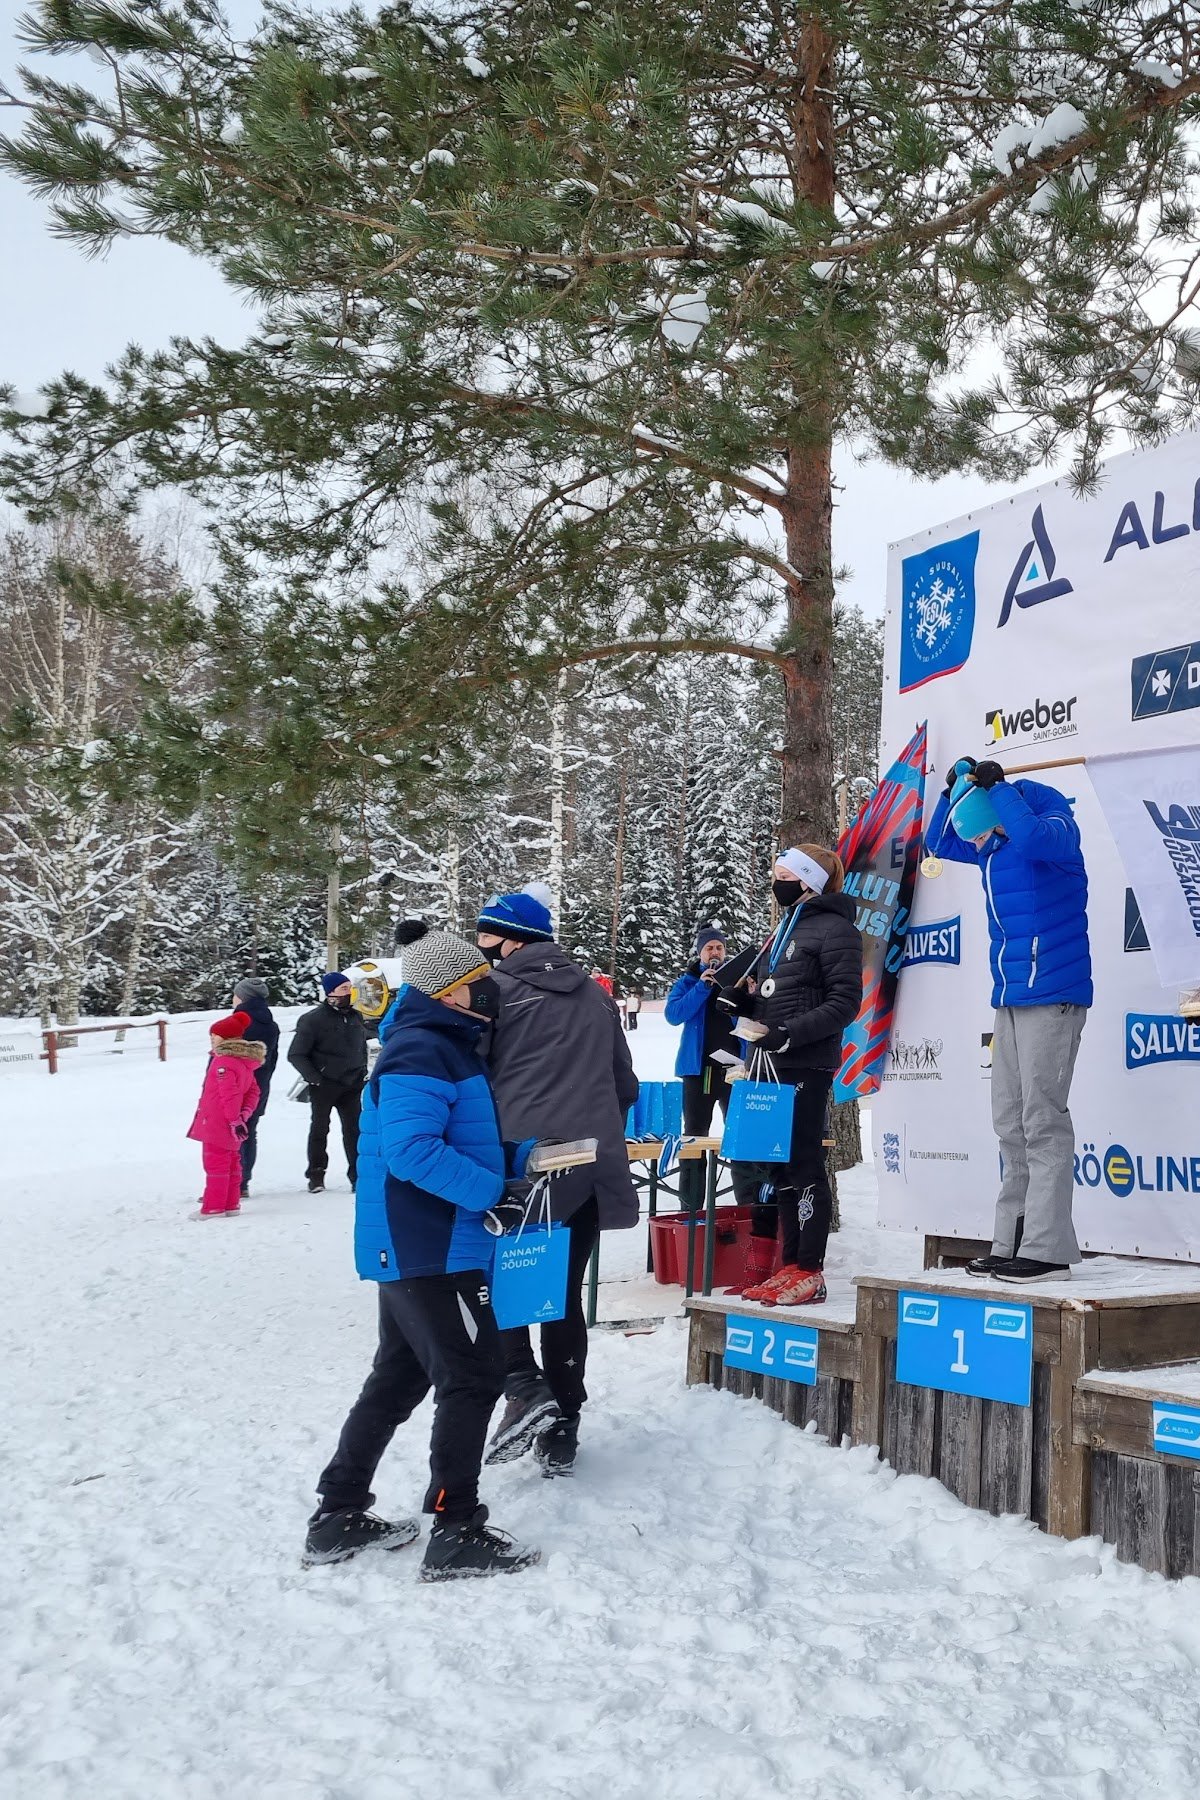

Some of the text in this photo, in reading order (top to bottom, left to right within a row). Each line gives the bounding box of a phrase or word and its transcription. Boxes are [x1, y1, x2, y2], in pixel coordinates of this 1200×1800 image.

[929, 561, 966, 599] SUUSALIIT
[1000, 697, 1077, 738] weber
[1032, 722, 1078, 741] SAINT-GOBAIN
[903, 925, 958, 961] ALVEST
[745, 1102, 771, 1111] JÕUDU
[746, 1093, 778, 1103] ANNAME
[501, 1245, 547, 1259] ANNAME
[501, 1257, 538, 1270] JÕUDU
[761, 1329, 775, 1366] 2
[950, 1329, 970, 1374] 1
